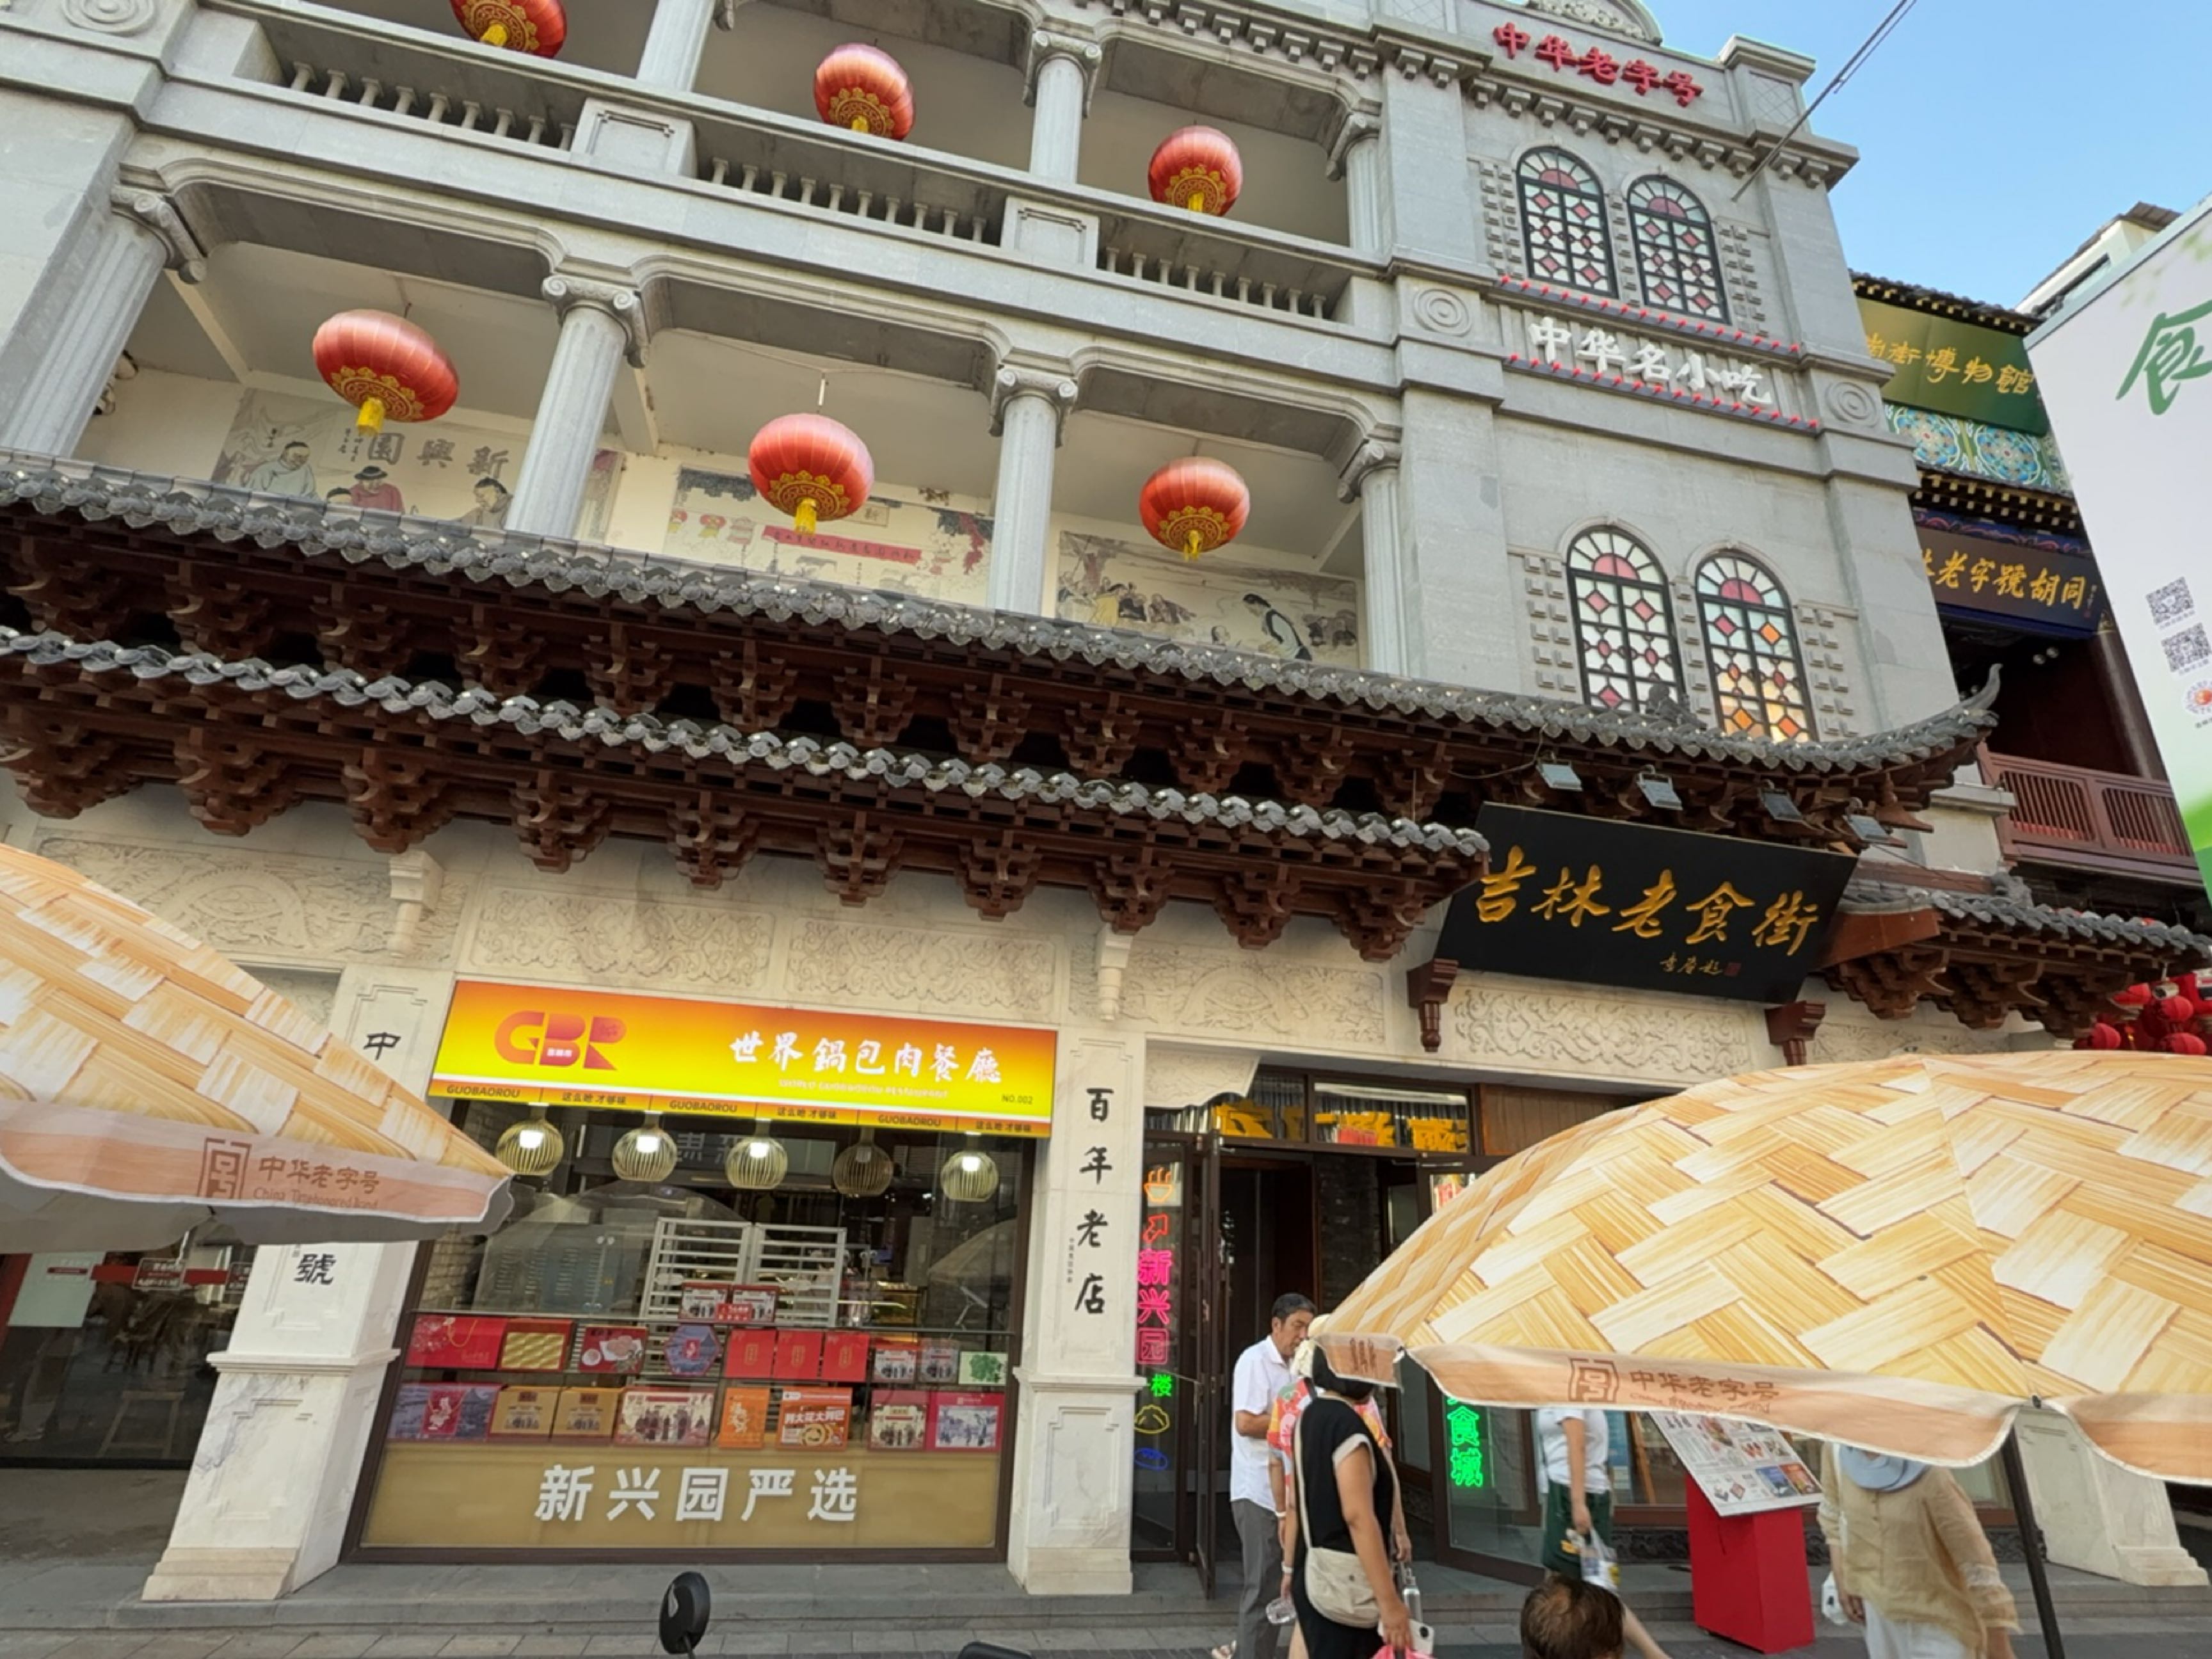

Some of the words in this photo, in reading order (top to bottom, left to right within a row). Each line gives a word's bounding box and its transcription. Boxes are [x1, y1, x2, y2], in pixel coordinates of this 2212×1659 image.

[1493, 22, 1704, 107] 中华老字号
[1528, 316, 1774, 406] 中华名小吃
[1475, 846, 1820, 956] 吉林老食街
[494, 1010, 627, 1071] GBR
[447, 1084, 520, 1098] GUOBAOROU
[669, 1100, 738, 1112] GUOBAOROU
[878, 1114, 942, 1126] GUOBAOROU
[1001, 1094, 1034, 1105] NO.002
[259, 1156, 379, 1194] 中华老字号
[1075, 1088, 1114, 1314] 百年老店
[1137, 1249, 1173, 1365] 新兴园
[1629, 1369, 1779, 1400] 中华老字号
[534, 1464, 857, 1522] 新兴园严选
